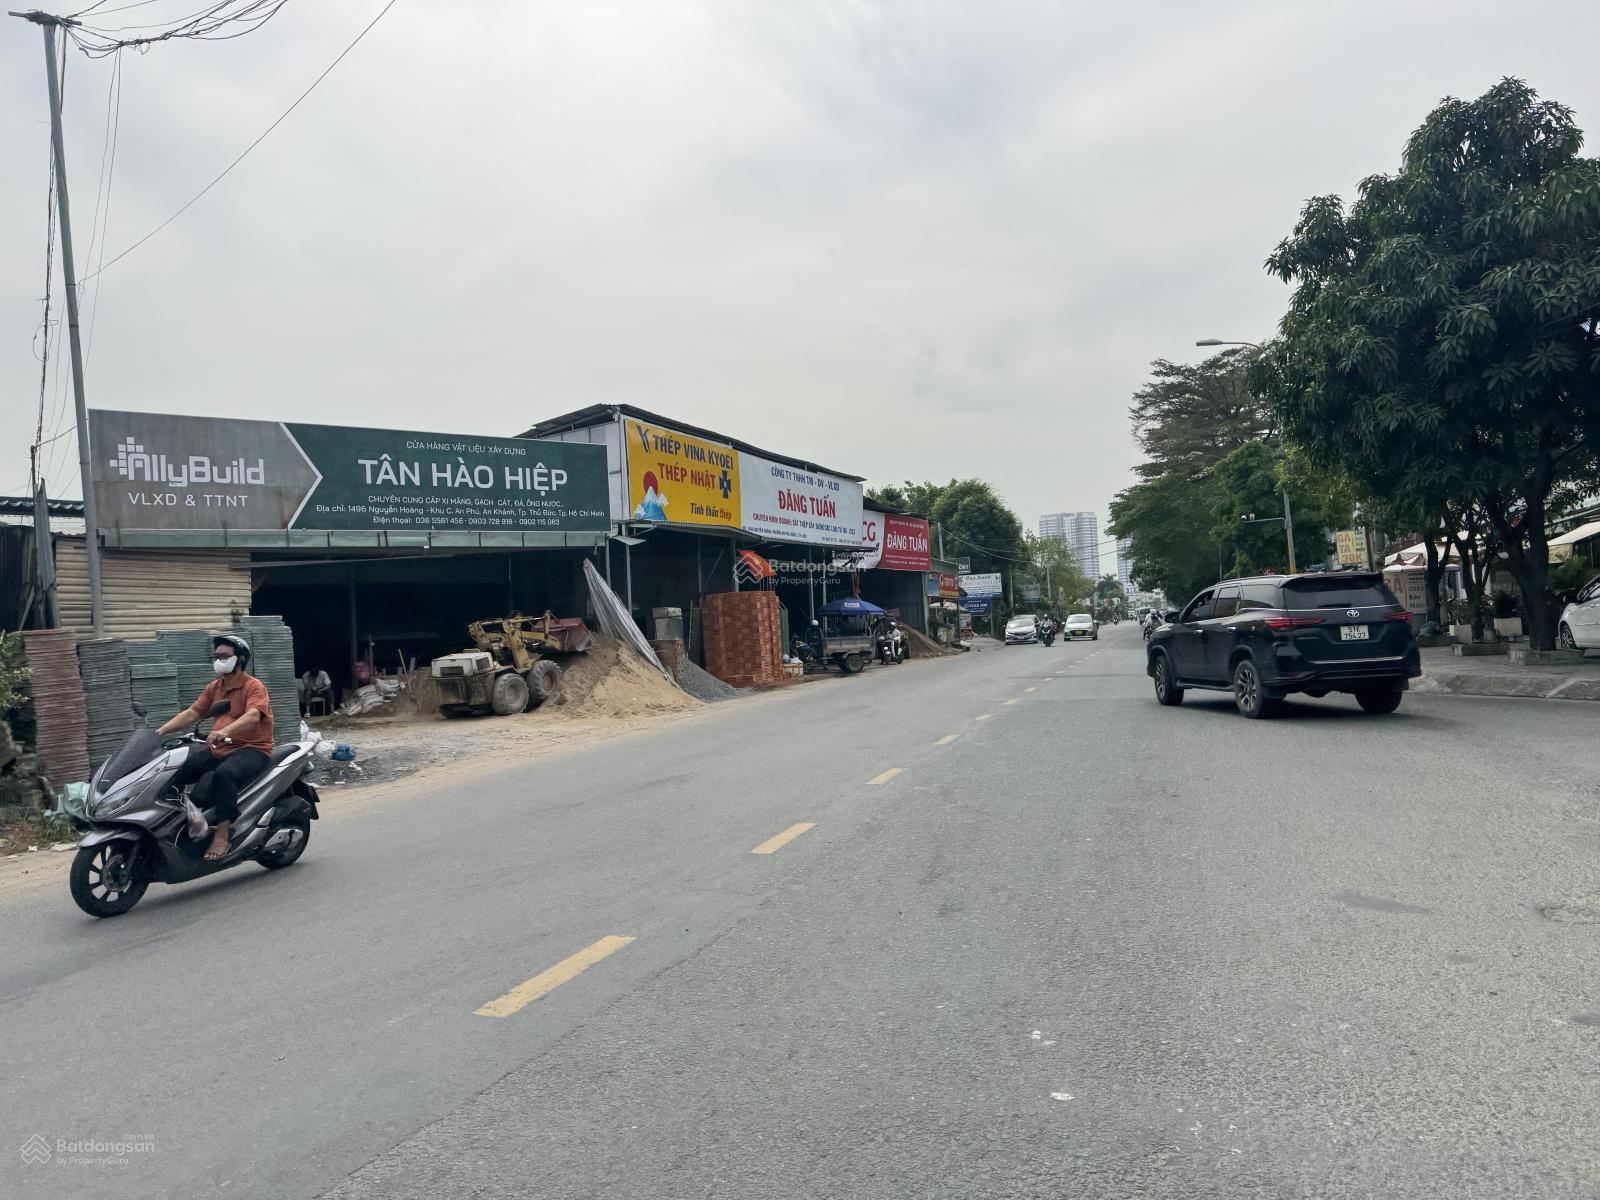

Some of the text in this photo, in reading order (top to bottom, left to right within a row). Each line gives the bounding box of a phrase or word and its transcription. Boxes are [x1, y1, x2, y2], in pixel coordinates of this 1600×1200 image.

[406, 440, 526, 456] CỬA HÀNG VẬT LIỆU XÂY DỰNG
[653, 435, 733, 470] THÉP VINA KYOEI
[128, 452, 265, 487] AllyBuild
[358, 453, 568, 496] TÂN HÀO HIỆP
[657, 462, 716, 491] THÉP NHẬT
[786, 470, 792, 480] TY
[128, 492, 248, 507] VLXD & TTNT
[368, 495, 401, 503] CHUYÊN
[425, 495, 440, 504] CẤP
[778, 488, 836, 519] ĐĂNG TUẤN
[316, 504, 330, 513] Địa
[332, 504, 346, 512] chỉ:
[369, 505, 398, 514] Nguyễn
[399, 506, 424, 515] Hoàng
[373, 515, 390, 524] Điện
[908, 532, 928, 552] TUẤN
